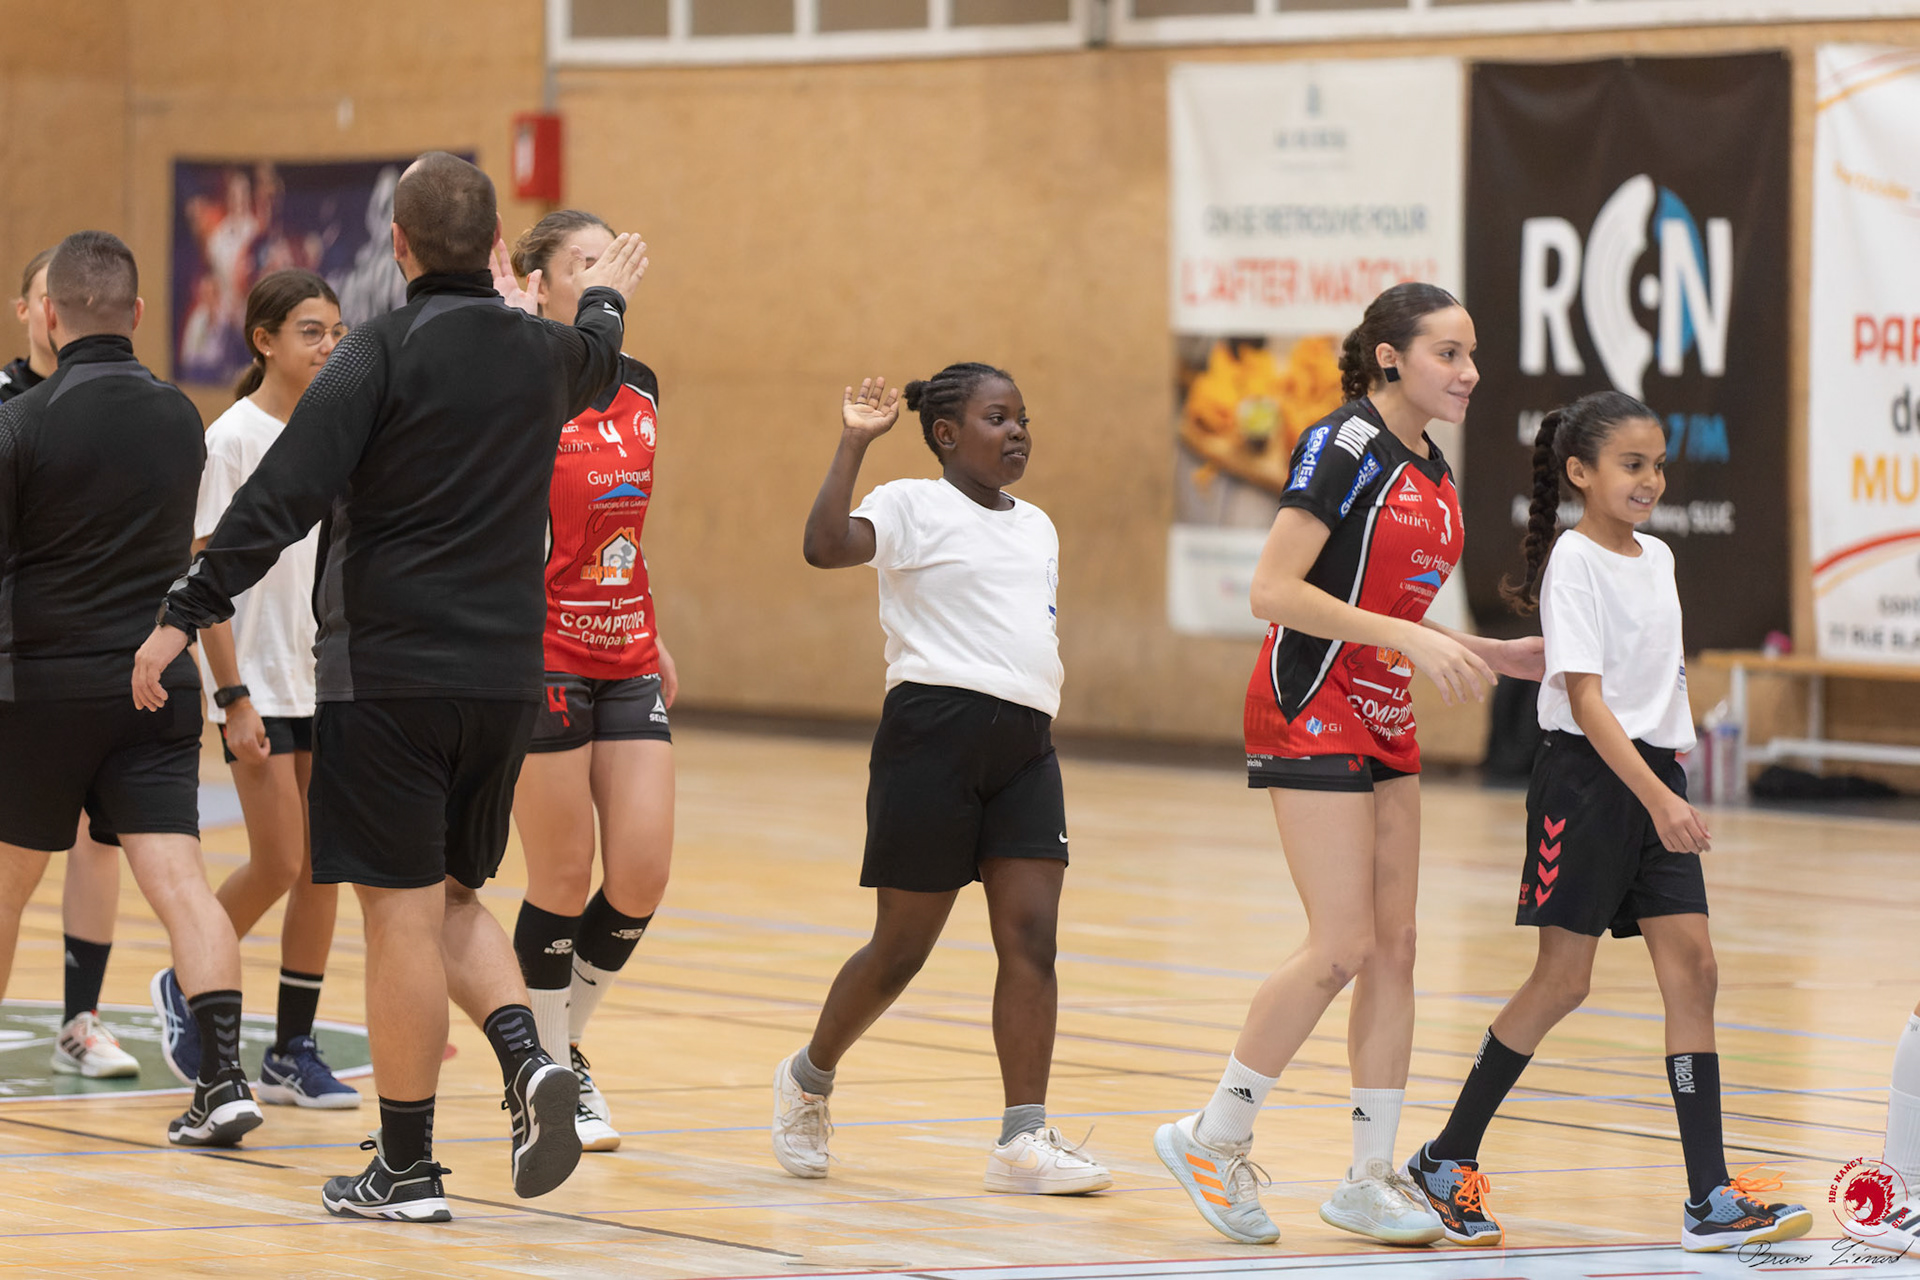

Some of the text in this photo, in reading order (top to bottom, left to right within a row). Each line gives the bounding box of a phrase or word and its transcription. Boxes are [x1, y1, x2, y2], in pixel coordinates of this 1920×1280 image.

[1518, 173, 1733, 403] RCN
[587, 469, 652, 487] Guy Hoquet
[1398, 494, 1422, 502] SELECT
[1411, 548, 1433, 569] Guy
[560, 610, 645, 634] COMPTOIR
[649, 713, 668, 724] SELEC
